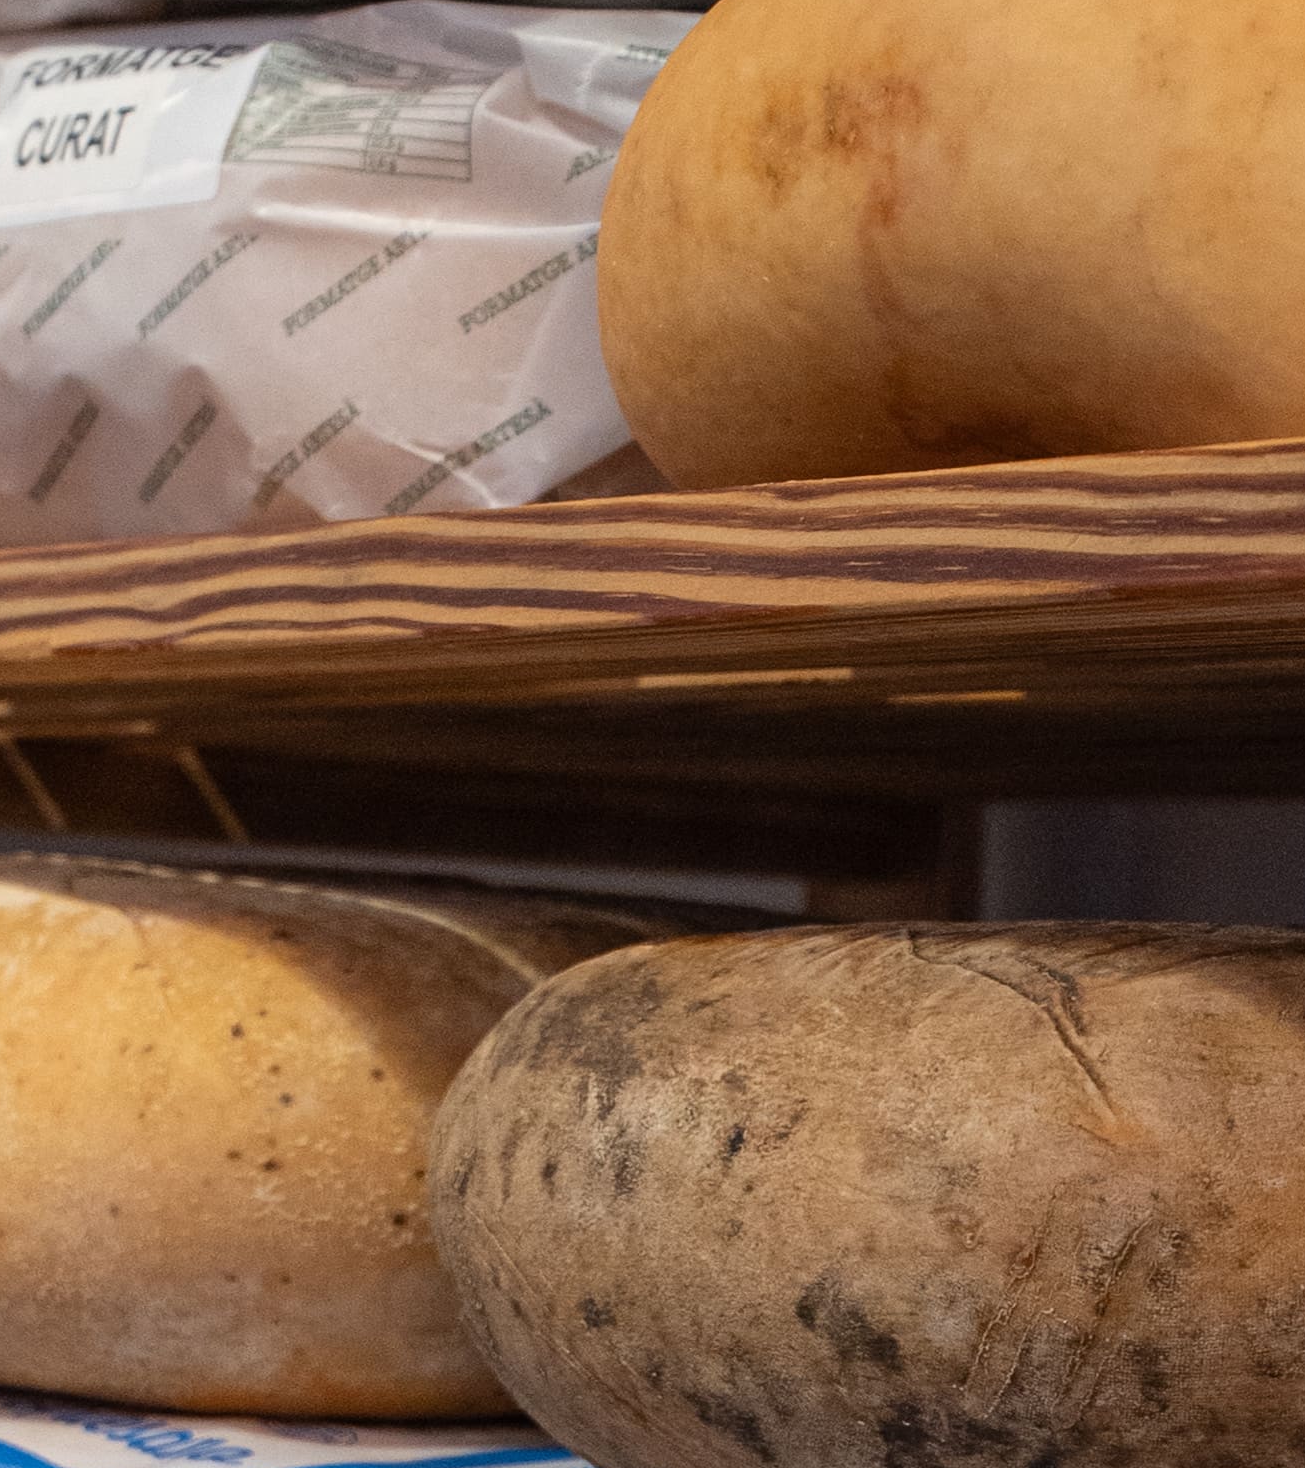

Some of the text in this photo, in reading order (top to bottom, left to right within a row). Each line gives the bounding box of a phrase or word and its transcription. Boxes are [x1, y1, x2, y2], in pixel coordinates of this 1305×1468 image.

[11, 43, 248, 101] FORMATGE
[14, 105, 135, 168] CURAT
[458, 250, 573, 335] FORMATGE
